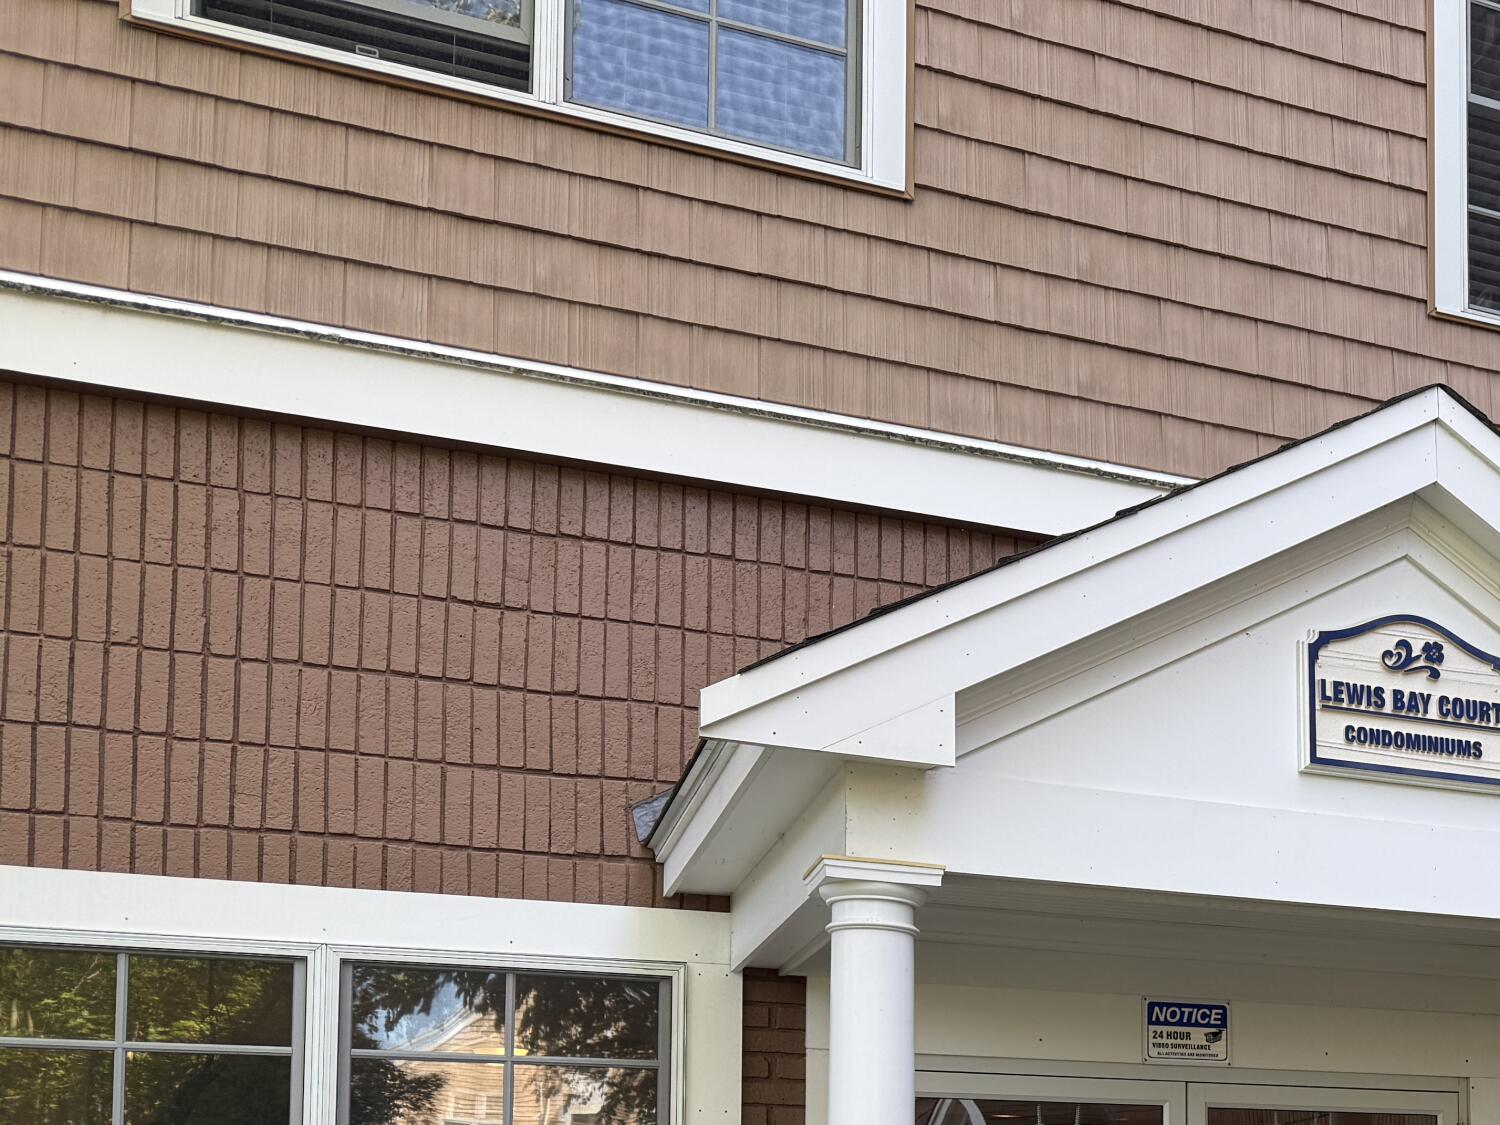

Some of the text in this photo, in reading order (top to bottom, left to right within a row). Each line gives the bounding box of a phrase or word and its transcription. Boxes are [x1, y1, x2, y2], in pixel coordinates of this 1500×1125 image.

[1319, 678, 1386, 709] LEWIS
[1392, 688, 1432, 715] BAY
[1344, 725, 1483, 759] CONDOMINIUMS
[1151, 1006, 1224, 1025] NOTICE
[1152, 1030, 1192, 1041] 24 HOUR
[1170, 1042, 1211, 1051] SURVEILLANCE
